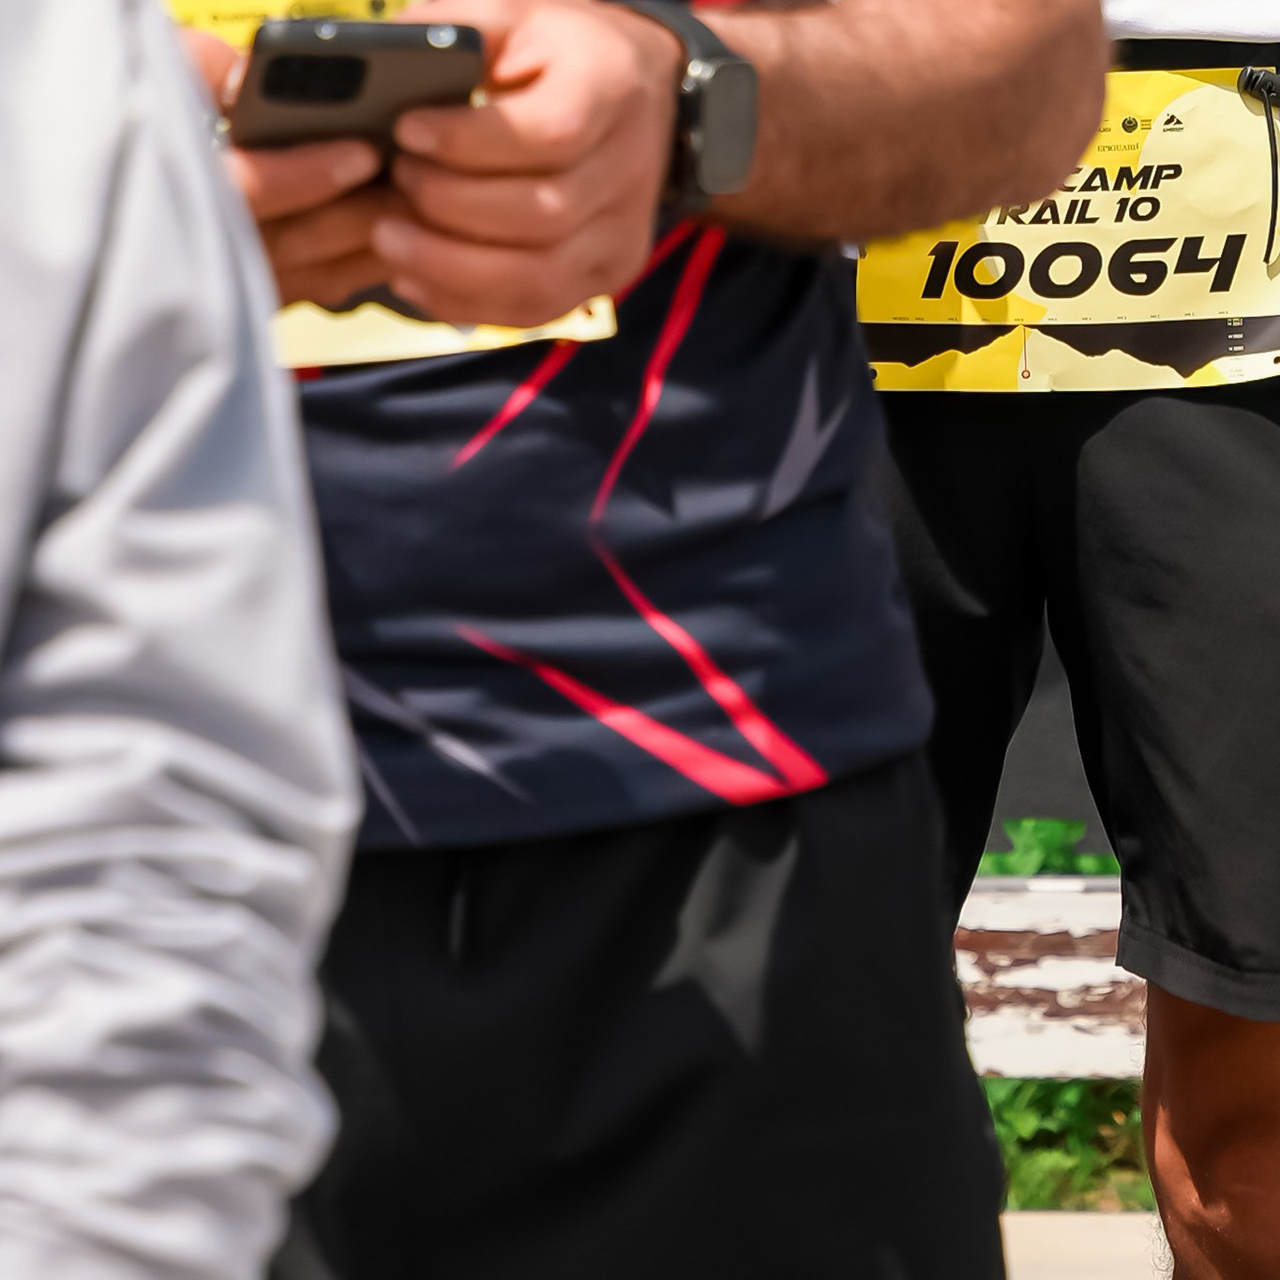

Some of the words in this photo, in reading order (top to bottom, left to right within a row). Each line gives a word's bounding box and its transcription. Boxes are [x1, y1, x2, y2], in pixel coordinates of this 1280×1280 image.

[978, 198, 1100, 225] RAIL
[1115, 196, 1161, 223] 10
[921, 234, 1247, 299] 10064
